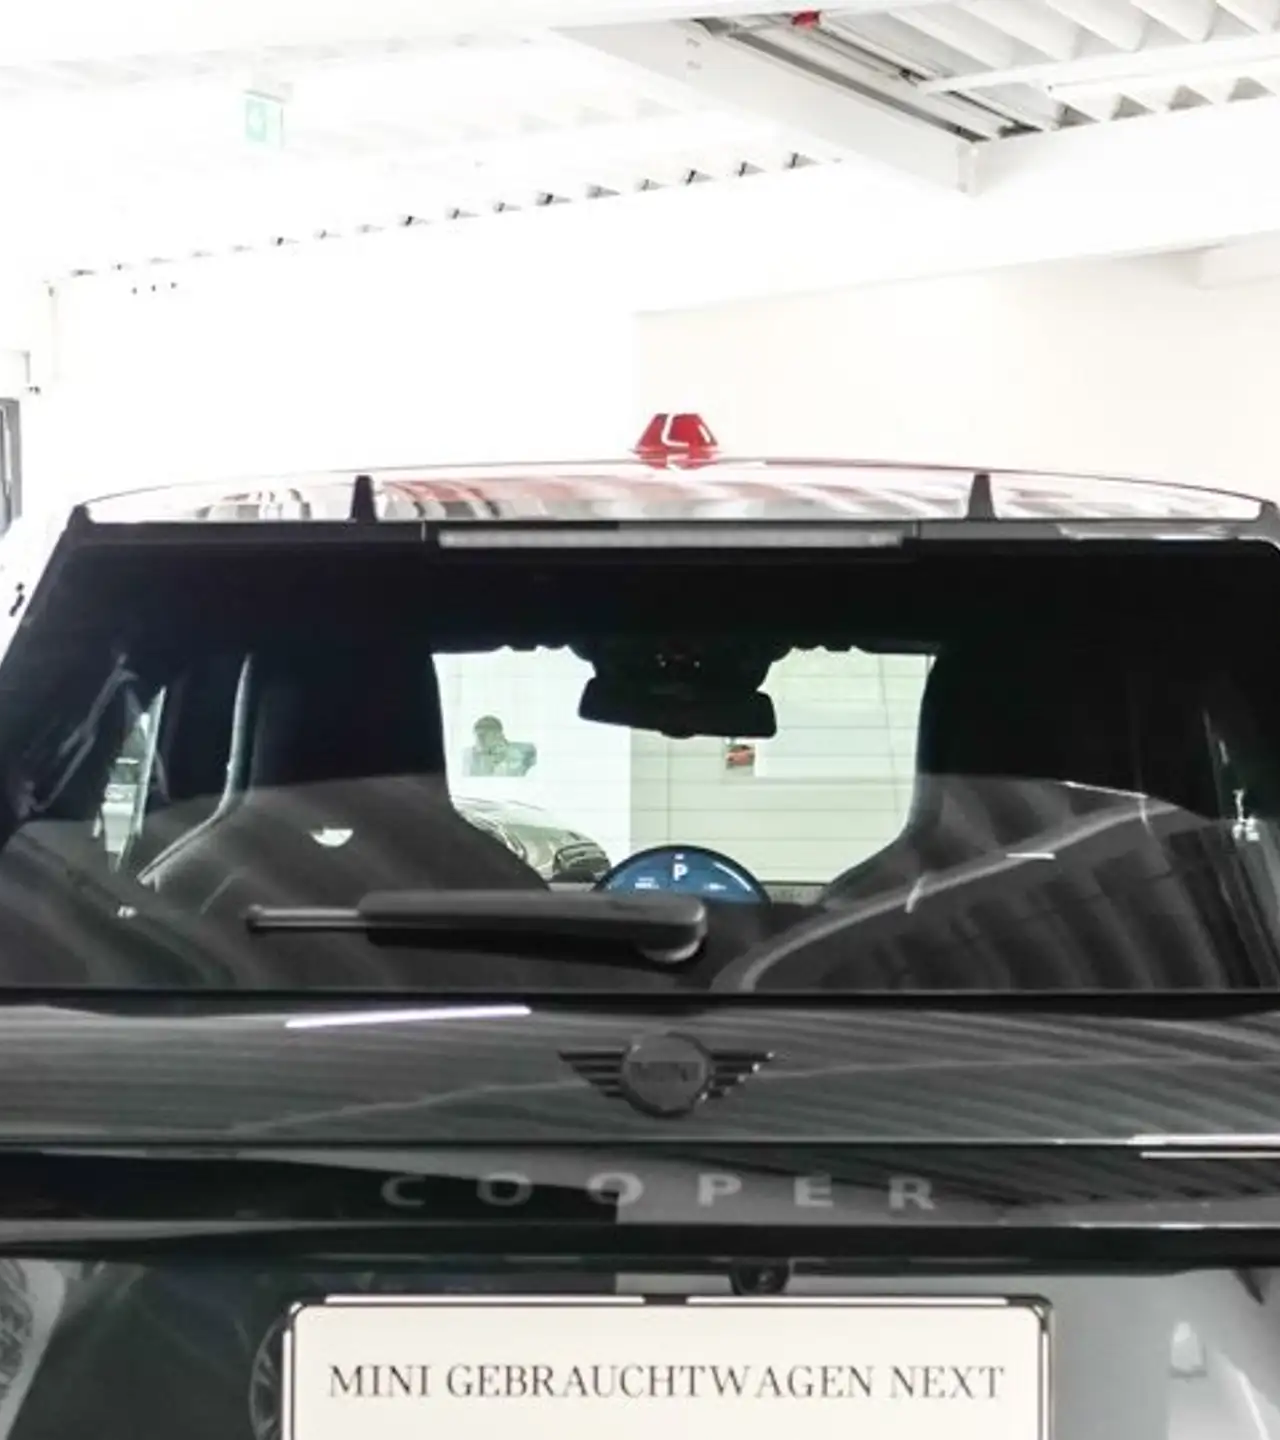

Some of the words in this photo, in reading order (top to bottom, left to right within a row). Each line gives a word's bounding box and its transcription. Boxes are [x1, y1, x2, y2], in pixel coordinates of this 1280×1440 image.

[672, 862, 689, 881] P
[380, 1170, 937, 1211] COOPER
[328, 1363, 432, 1398] MINI
[445, 1363, 874, 1399] GEBRAUCHTWAGEN
[889, 1364, 1006, 1400] NEXT
